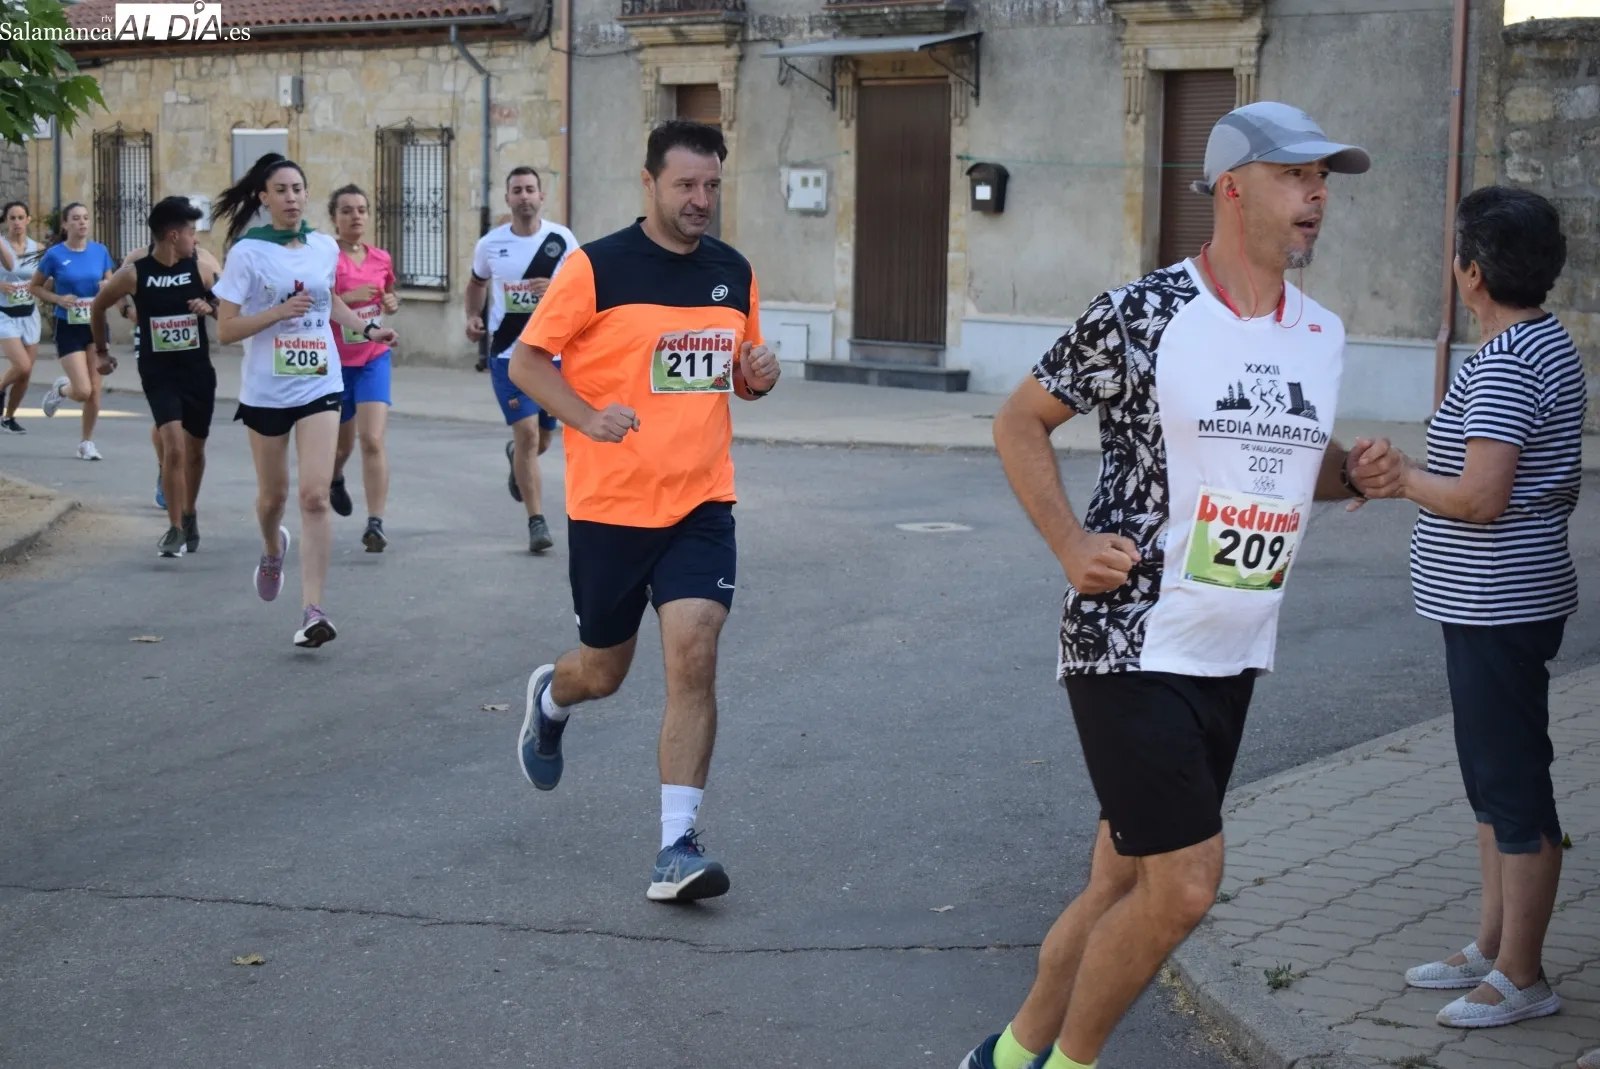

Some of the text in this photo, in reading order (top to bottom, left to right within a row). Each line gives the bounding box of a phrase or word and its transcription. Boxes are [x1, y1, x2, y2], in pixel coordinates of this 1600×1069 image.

[146, 272, 192, 288] NIKE
[512, 292, 539, 305] 245
[152, 317, 197, 330] bedunia
[161, 328, 191, 343] 230
[274, 336, 327, 350] bedunia
[655, 332, 733, 352] bedunia
[285, 350, 319, 367] 208
[667, 352, 713, 378] 211
[1244, 362, 1281, 376] XXXII
[1198, 418, 1329, 445] MEDIA MARATÓN
[1240, 443, 1251, 451] DE
[1248, 455, 1284, 475] 2021
[1196, 494, 1300, 533] bedunia
[1213, 528, 1285, 571] 209
